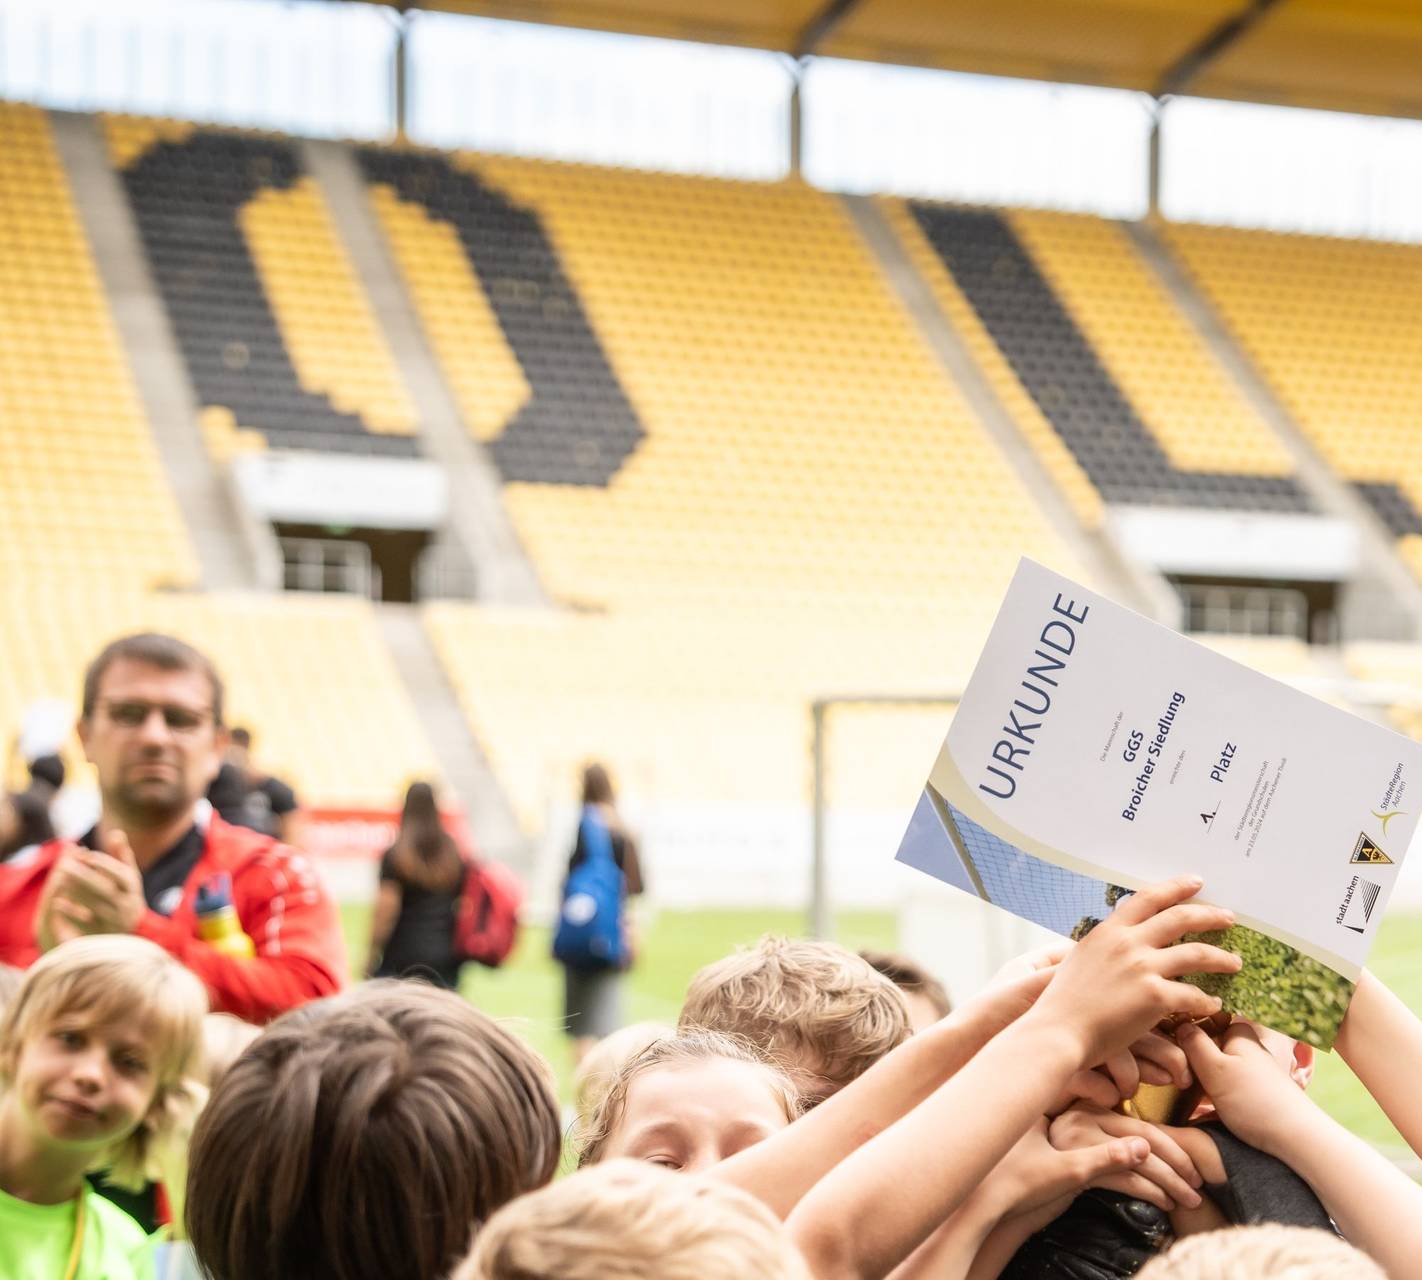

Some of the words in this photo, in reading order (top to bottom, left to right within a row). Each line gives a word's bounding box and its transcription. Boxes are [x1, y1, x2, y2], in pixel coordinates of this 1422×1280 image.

[979, 593, 1089, 799] URKUNDE
[1122, 758, 1155, 821] Broicher
[1148, 692, 1185, 757] Siedlung
[1123, 730, 1143, 762] GGS
[1200, 812, 1216, 823] 1.
[1210, 743, 1236, 782] Platz
[1391, 780, 1406, 808] Aachen
